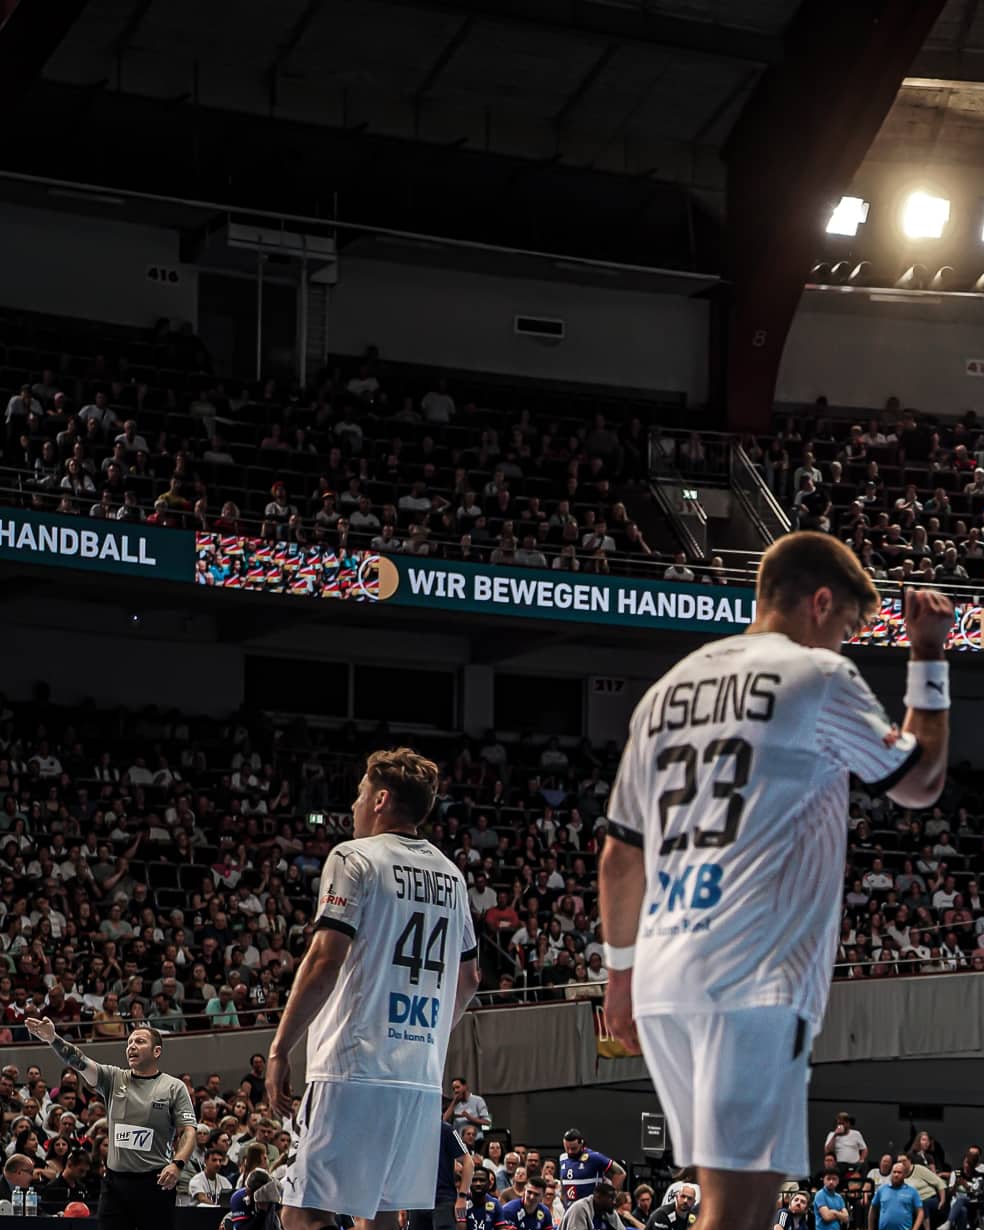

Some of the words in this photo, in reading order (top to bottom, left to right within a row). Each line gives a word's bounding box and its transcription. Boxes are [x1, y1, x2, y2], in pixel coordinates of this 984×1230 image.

[0, 519, 157, 566] HANDBALL
[408, 568, 466, 599] WIR
[474, 576, 609, 612] BEWEGEN
[648, 672, 781, 737] USCINS
[656, 737, 754, 856] 23
[393, 865, 458, 910] STEINERT
[392, 911, 449, 989] 44
[132, 1130, 151, 1147] TV
[566, 1168, 574, 1179] 8
